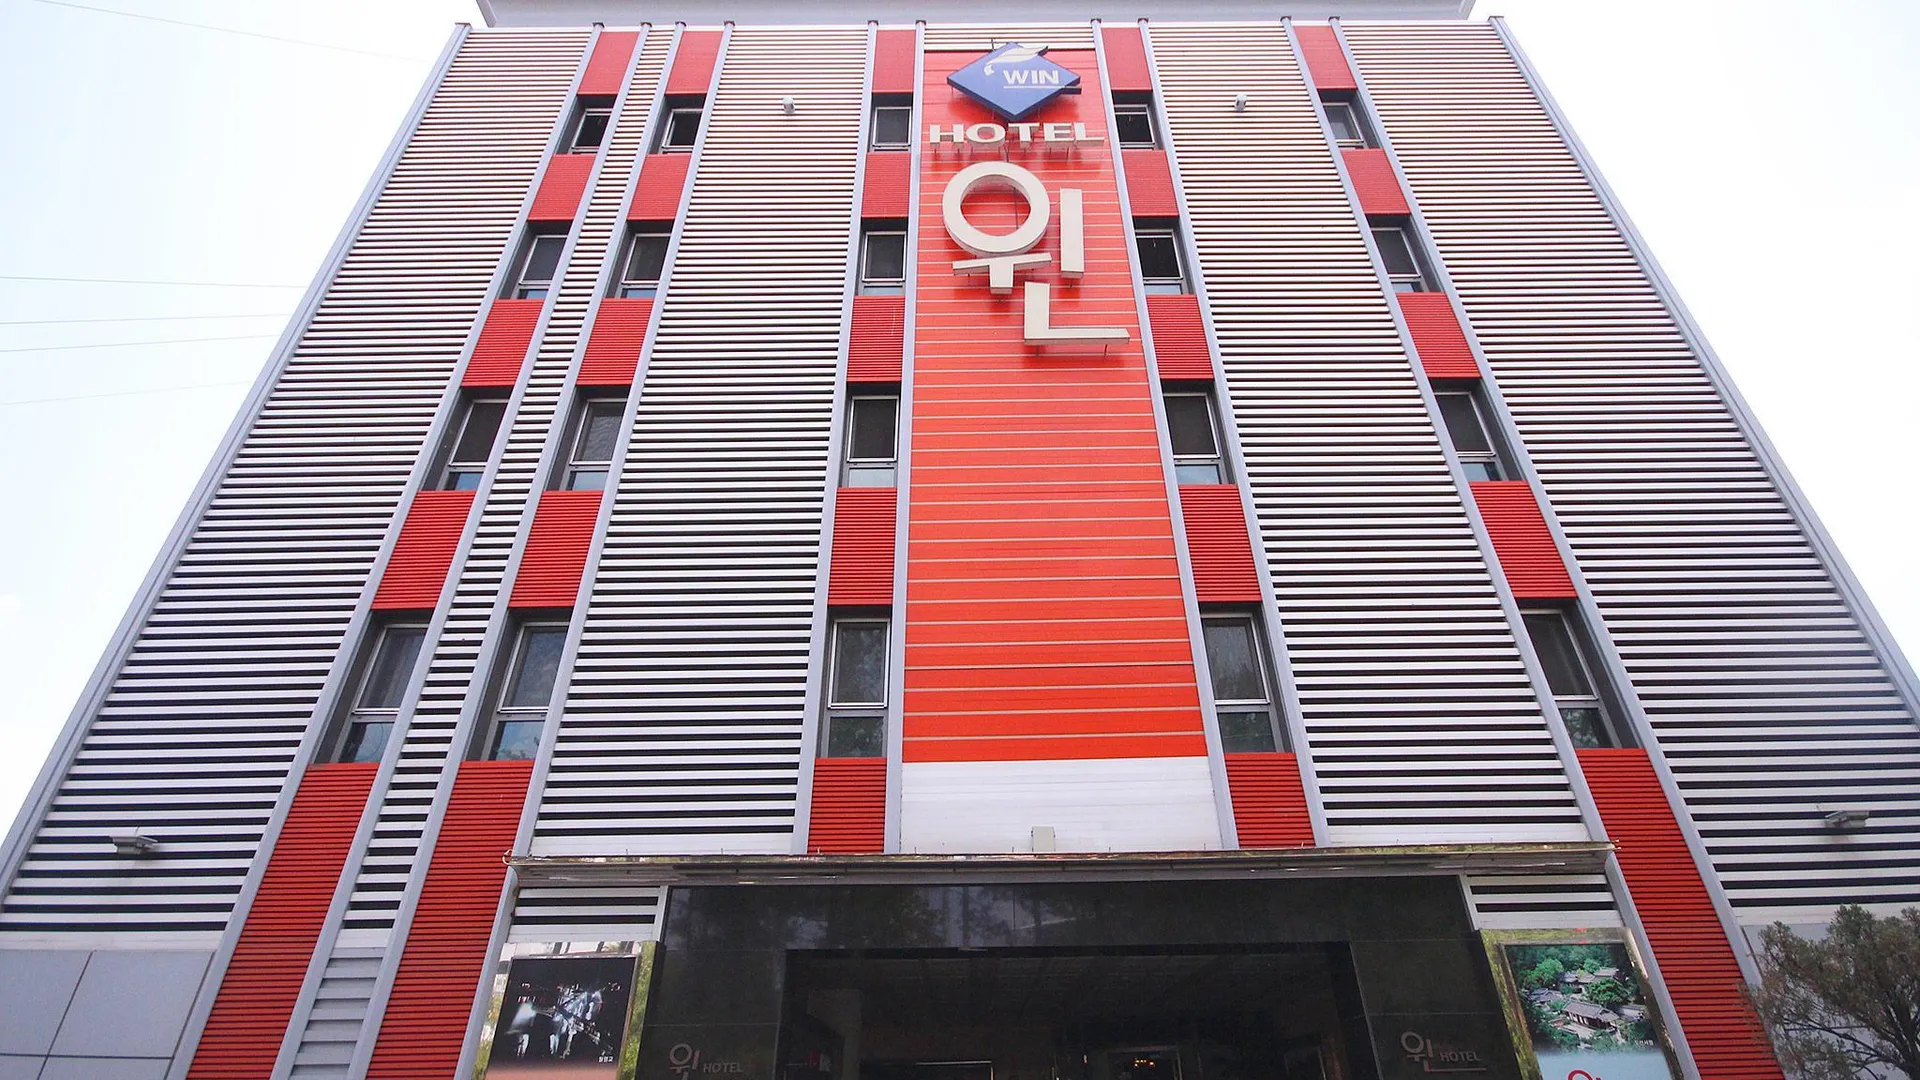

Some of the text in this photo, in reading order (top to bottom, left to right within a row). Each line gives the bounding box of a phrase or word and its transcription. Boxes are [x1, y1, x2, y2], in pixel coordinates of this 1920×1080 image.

[1003, 69, 1059, 84] WIN
[929, 122, 1104, 148] HOTEL
[942, 161, 1131, 344] 윈
[1440, 1052, 1482, 1062] HOTEL
[703, 1062, 743, 1074] HOTEL
